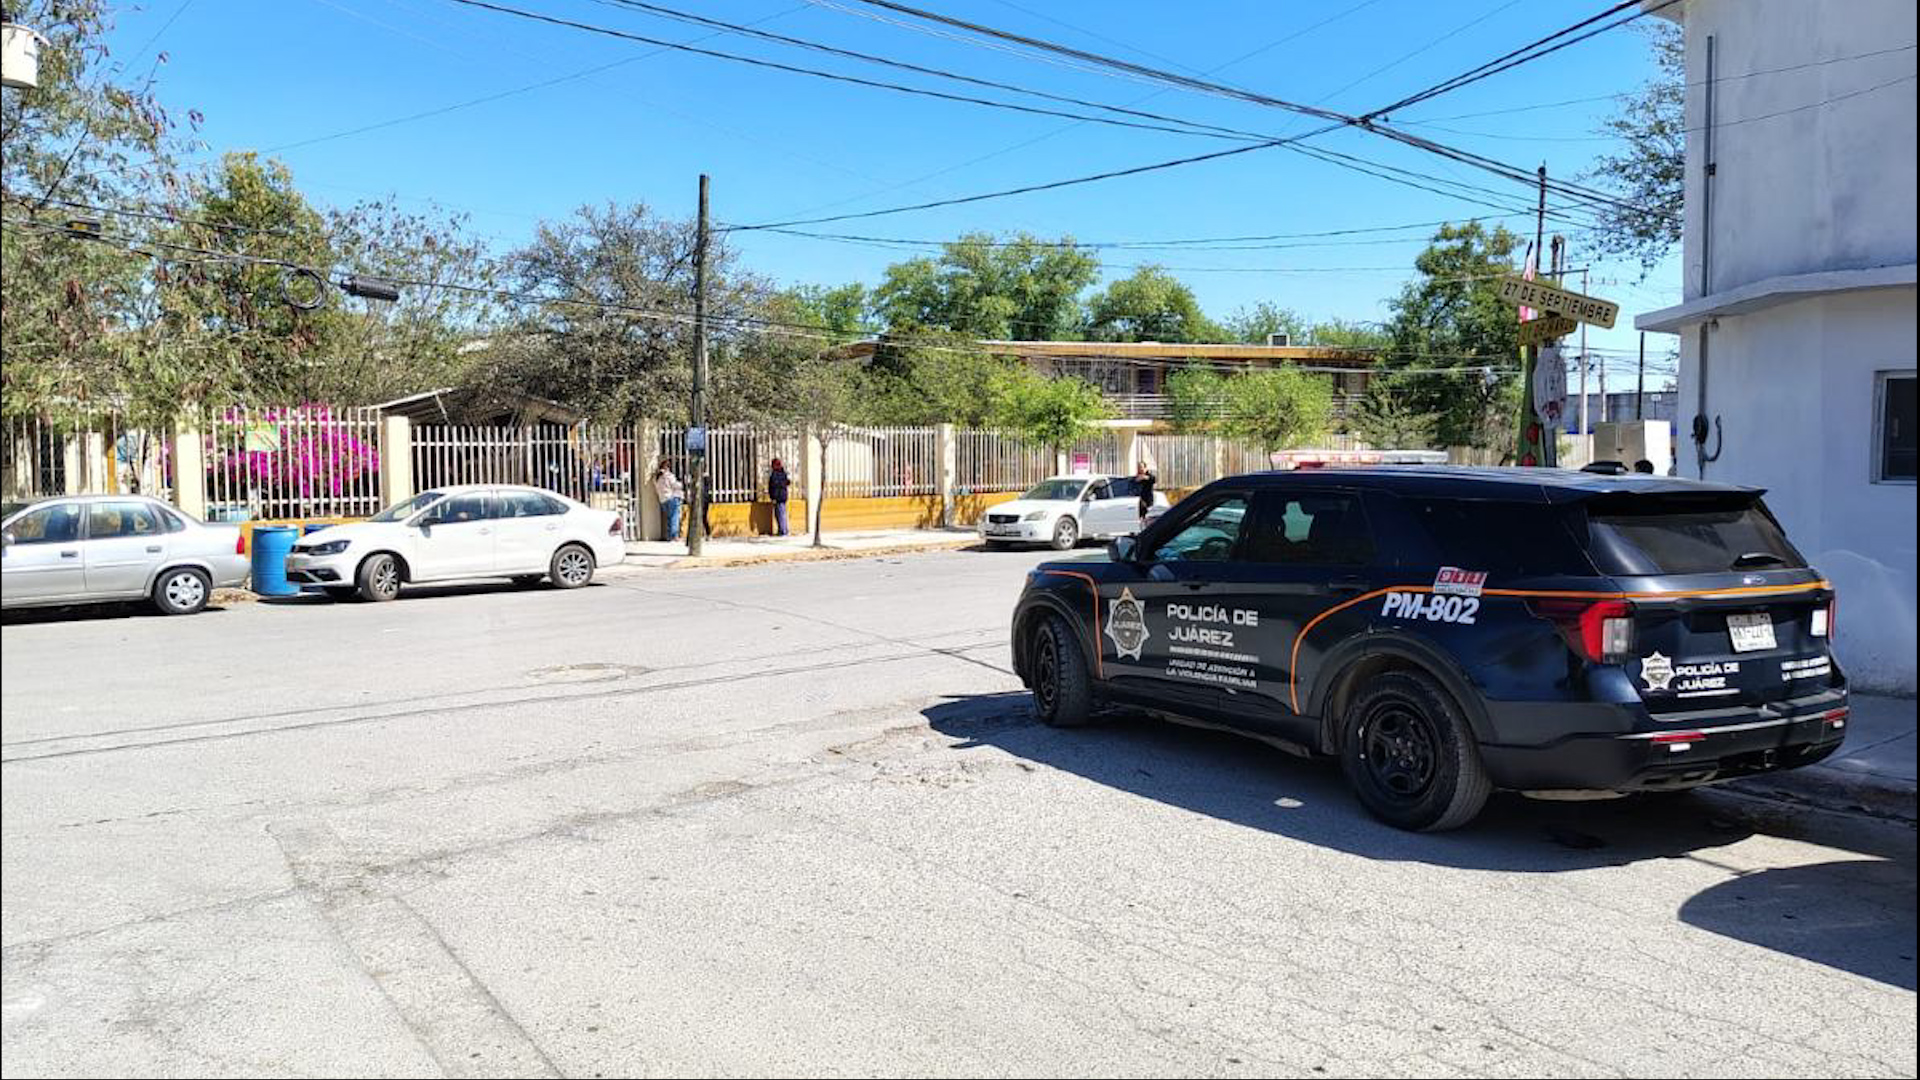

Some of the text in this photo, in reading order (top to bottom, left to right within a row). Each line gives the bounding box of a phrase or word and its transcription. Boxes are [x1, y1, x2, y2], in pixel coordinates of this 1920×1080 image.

[1503, 282, 1611, 321] 27 DE SEPTIEMBRE
[1439, 571, 1481, 583] 911
[1167, 603, 1258, 627] POLICÍA DE
[1381, 592, 1480, 624] PM-802
[1168, 624, 1234, 647] JUÁREZ
[1166, 667, 1177, 675] LA
[1676, 660, 1722, 677] POLICÍA
[1724, 662, 1739, 673] DE
[1677, 677, 1726, 690] JUÁREZ
